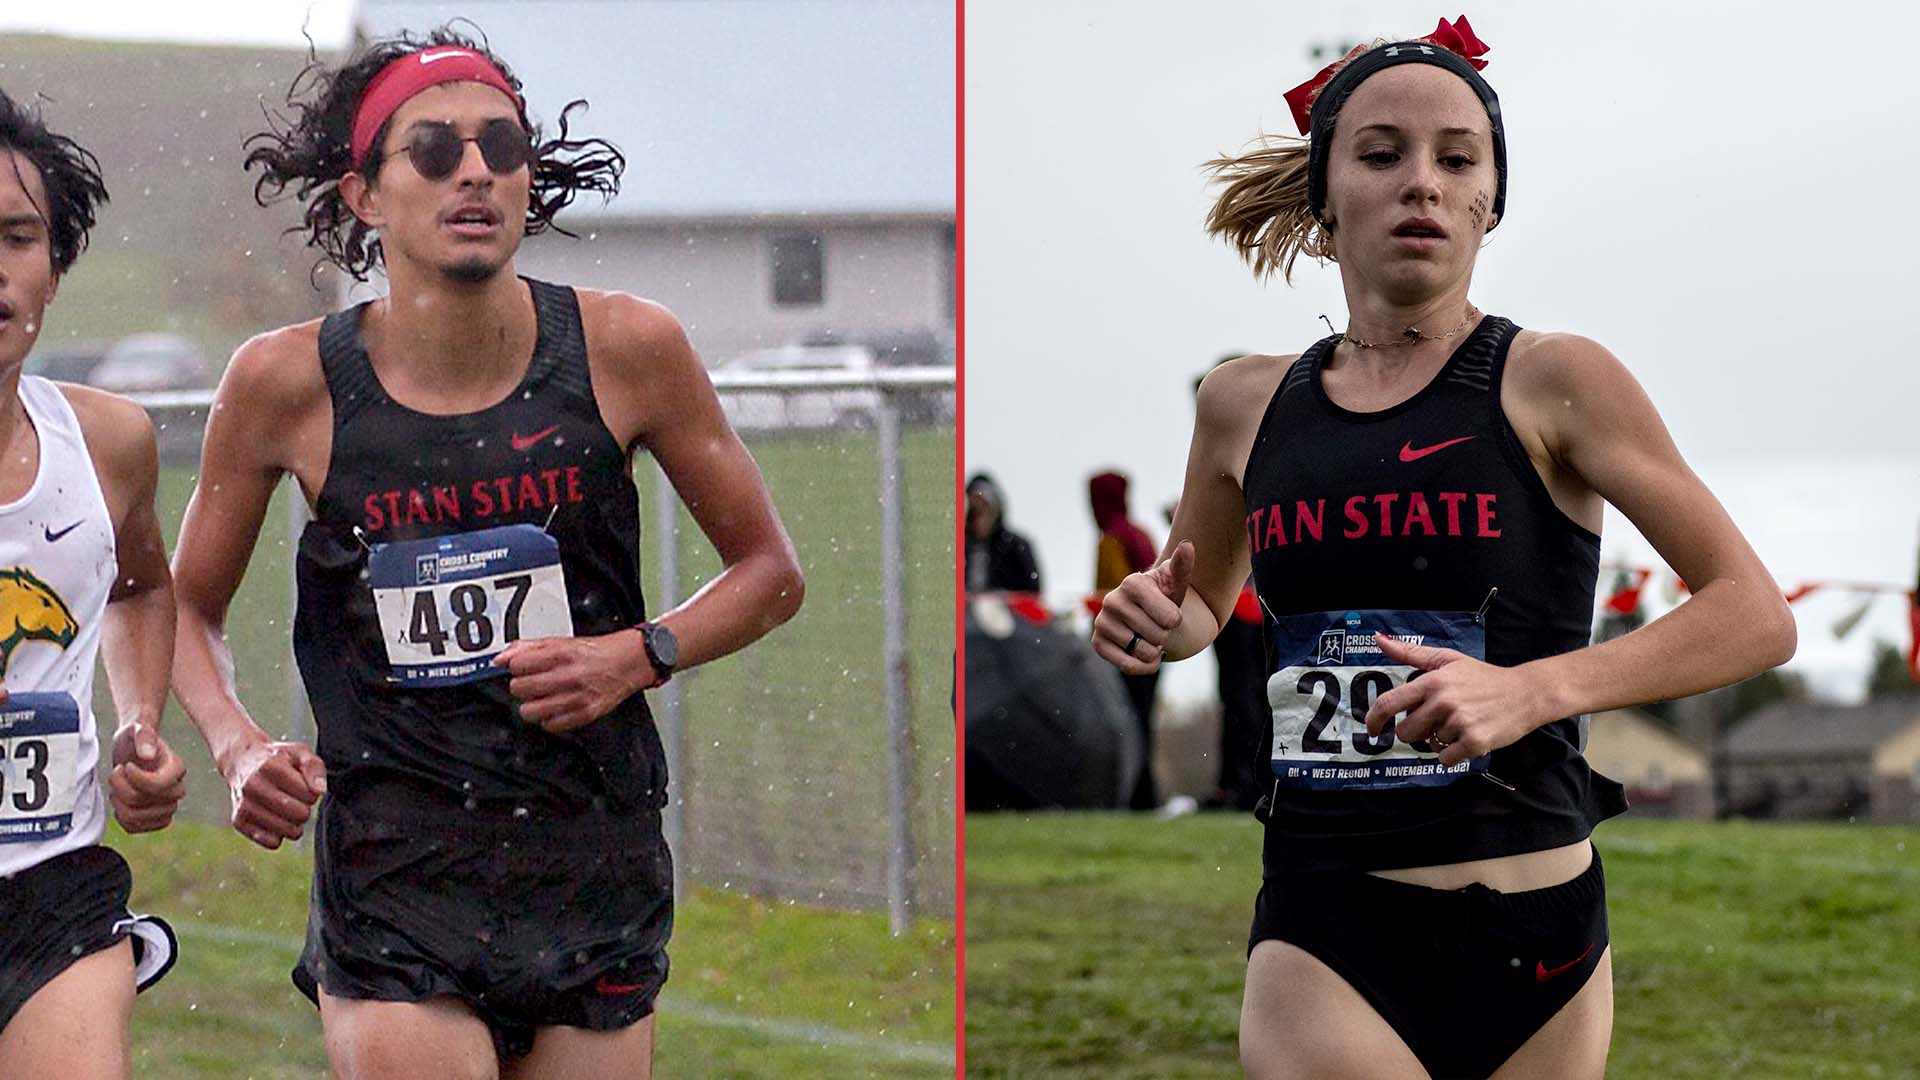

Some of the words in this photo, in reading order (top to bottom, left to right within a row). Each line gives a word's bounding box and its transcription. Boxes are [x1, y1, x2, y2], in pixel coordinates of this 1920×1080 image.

[364, 484, 462, 531] STAN
[472, 466, 584, 517] STATE
[1247, 499, 1326, 555] TAN
[1343, 492, 1502, 539] STATE
[409, 574, 532, 656] 487
[1345, 646, 1383, 654] CHAMPIONS
[1346, 635, 1376, 646] CROSS
[0, 740, 49, 812] 3
[1312, 768, 1336, 779] WEST
[1337, 767, 1371, 779] REGION
[1385, 765, 1435, 777] NOVEMBER
